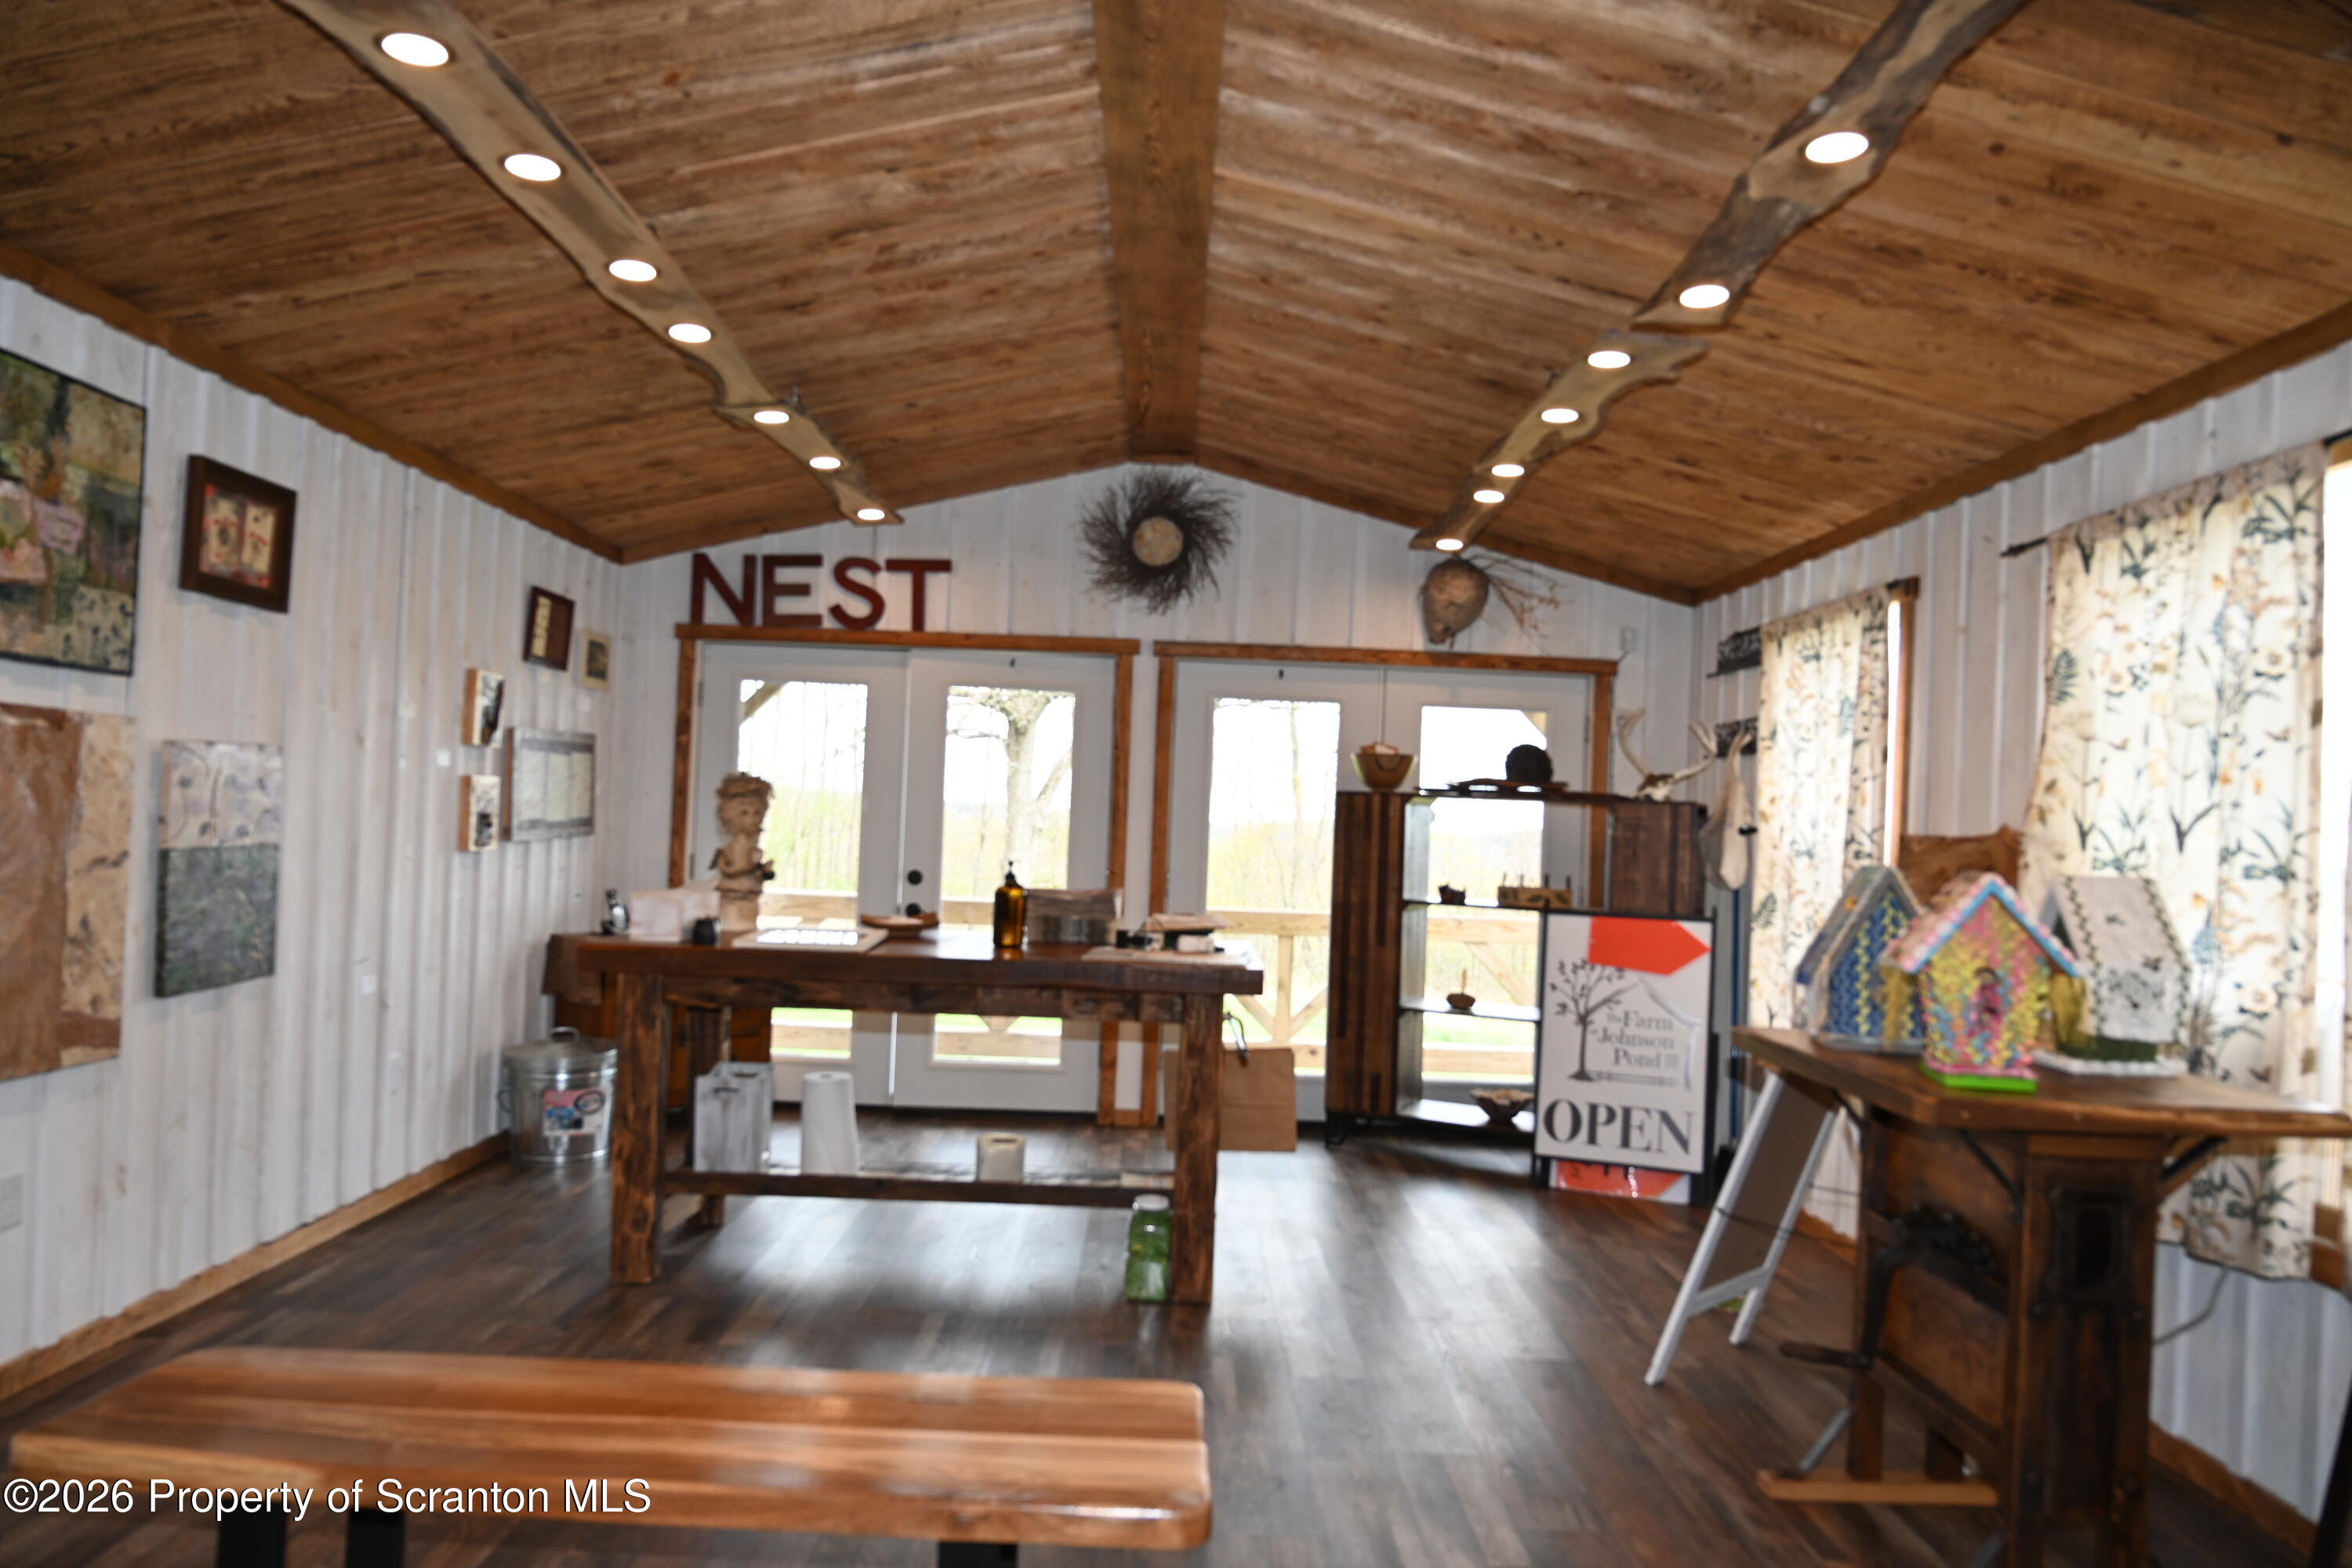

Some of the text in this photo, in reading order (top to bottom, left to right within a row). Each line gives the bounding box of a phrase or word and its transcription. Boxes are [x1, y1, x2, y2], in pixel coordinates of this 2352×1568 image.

[691, 553, 952, 632] NEST
[1623, 1009, 1674, 1032] Farm
[1598, 1025, 1675, 1049] Johnson
[1613, 1047, 1661, 1069] Pond
[1543, 1098, 1697, 1156] OPEN
